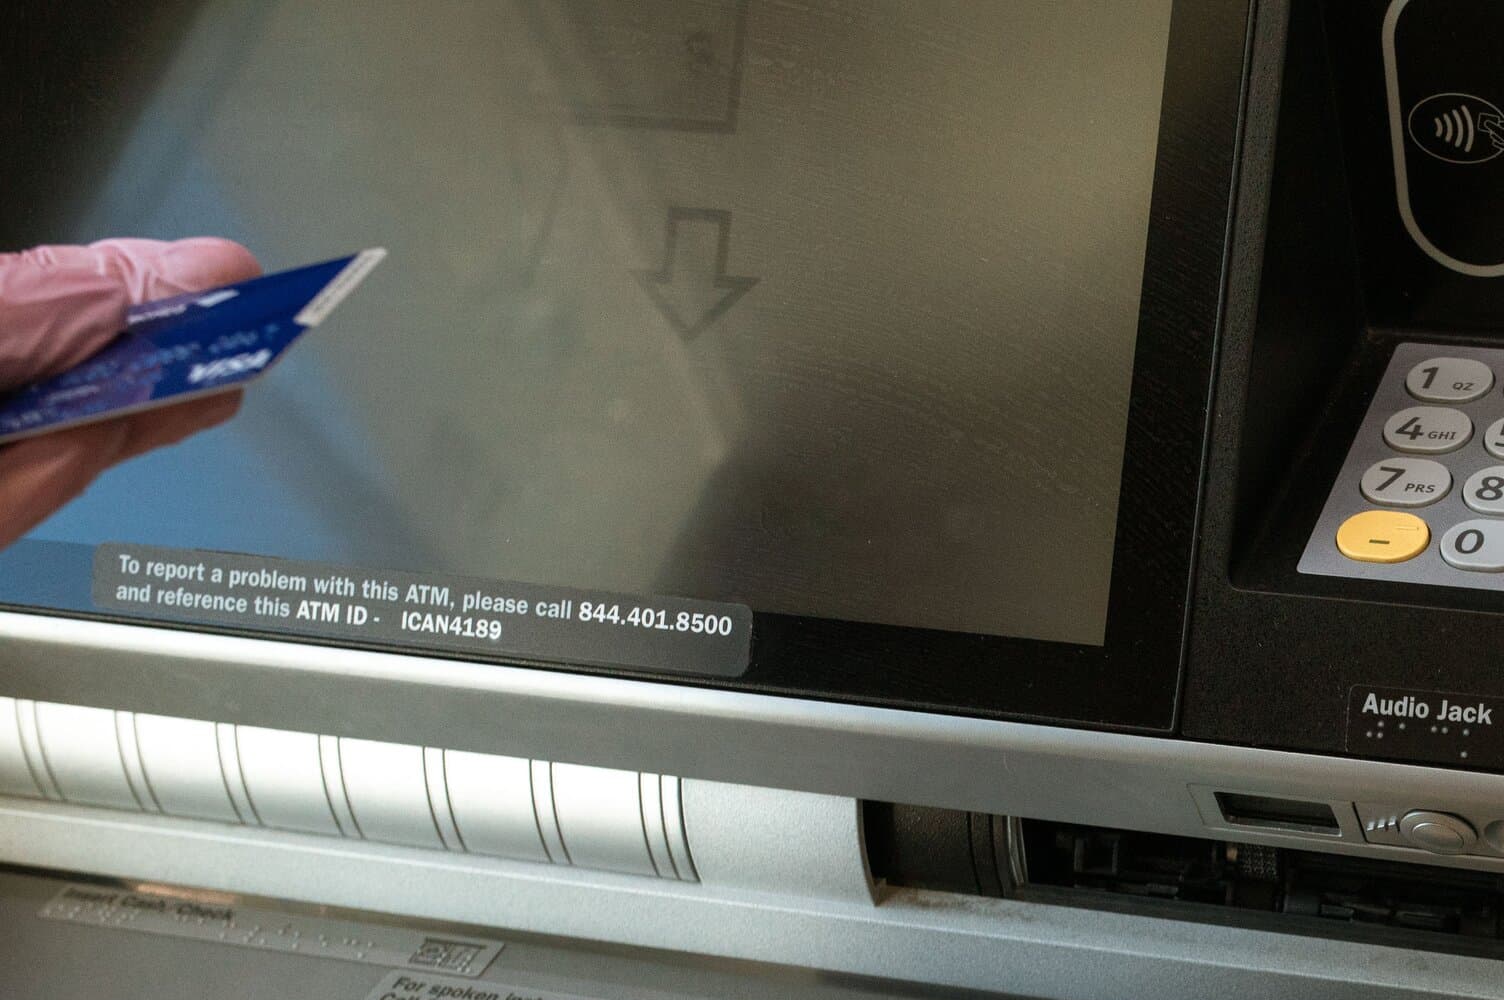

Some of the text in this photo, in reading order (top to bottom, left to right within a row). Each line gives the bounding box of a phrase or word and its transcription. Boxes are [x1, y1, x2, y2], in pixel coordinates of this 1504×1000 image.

[1422, 366, 1475, 392] 1 QZ
[1395, 416, 1456, 441] 4 GHI
[1375, 466, 1435, 493] 7 PRS
[119, 554, 733, 636] To report a problem with this ATM, please call 844.401.8500
[116, 584, 151, 602] and
[156, 587, 248, 612] reference
[254, 596, 291, 617] this
[296, 599, 340, 623] ATM
[347, 604, 368, 625] ID
[401, 610, 502, 640] ICAN4189
[1362, 692, 1493, 725] Audio Jack
[392, 977, 426, 993] For
